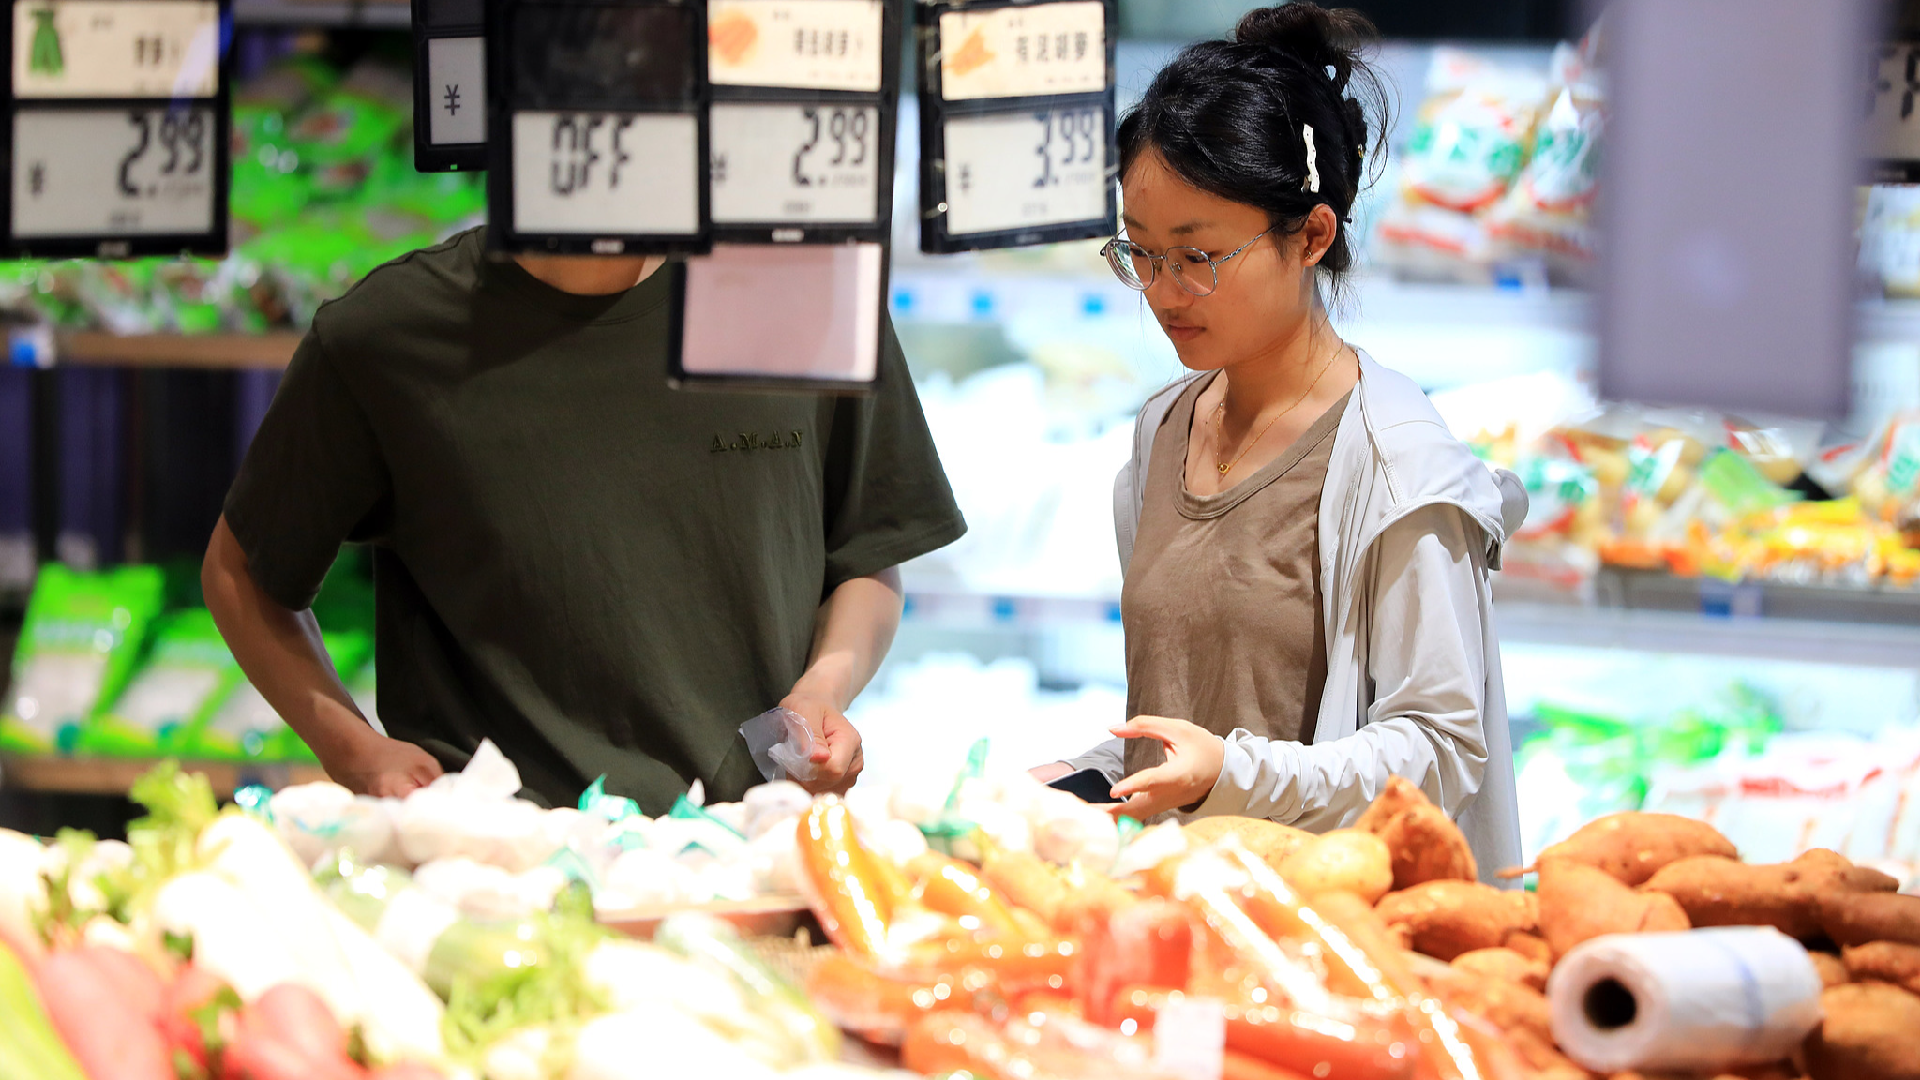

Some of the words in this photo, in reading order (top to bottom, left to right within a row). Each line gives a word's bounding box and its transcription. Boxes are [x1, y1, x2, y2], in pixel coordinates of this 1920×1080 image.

[442, 83, 462, 117] ¥
[117, 110, 205, 197] 2.99
[550, 115, 635, 195] OFF
[792, 108, 868, 187] 2.99
[1031, 112, 1096, 189] 3.99
